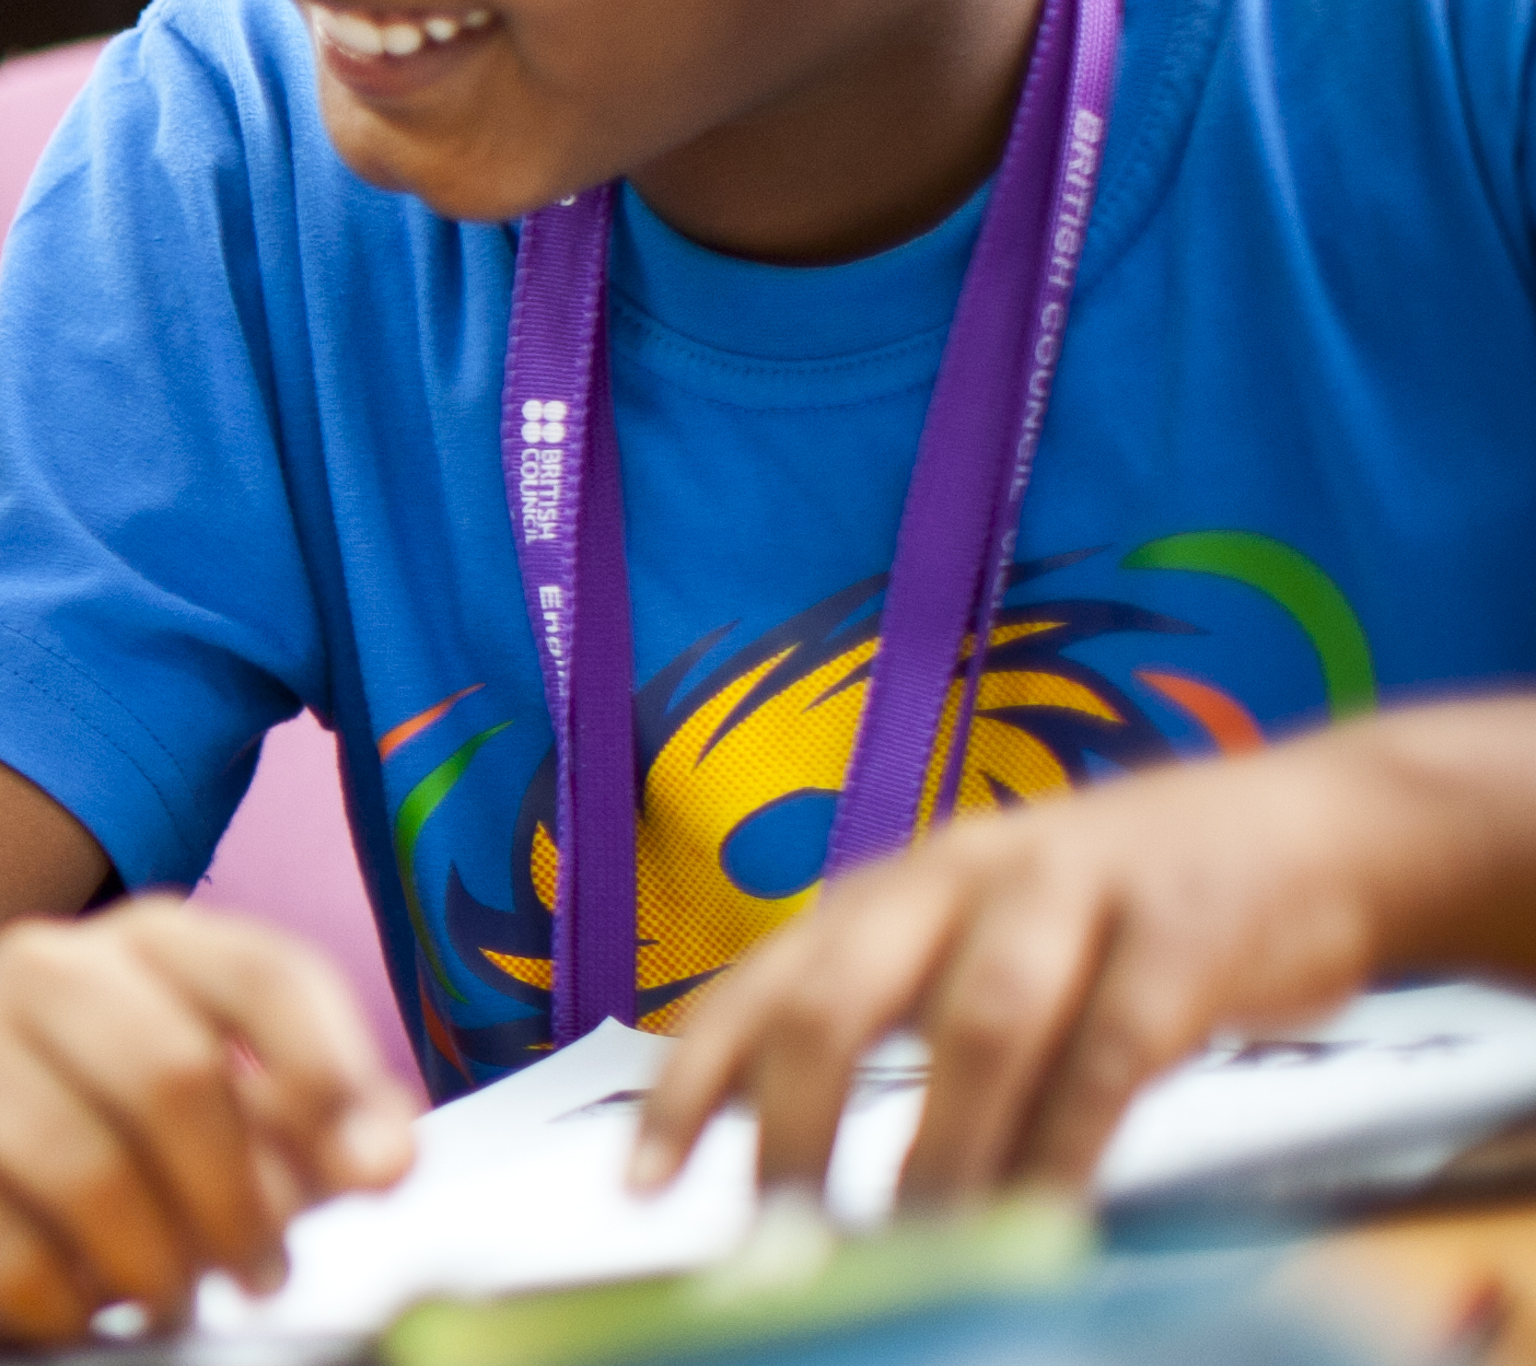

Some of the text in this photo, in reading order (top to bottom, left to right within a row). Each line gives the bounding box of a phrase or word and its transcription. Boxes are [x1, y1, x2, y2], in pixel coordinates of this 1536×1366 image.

[1048, 109, 1103, 287] BRITISH
[519, 447, 541, 546] COUNCIL
[541, 448, 564, 541] BRITISH
